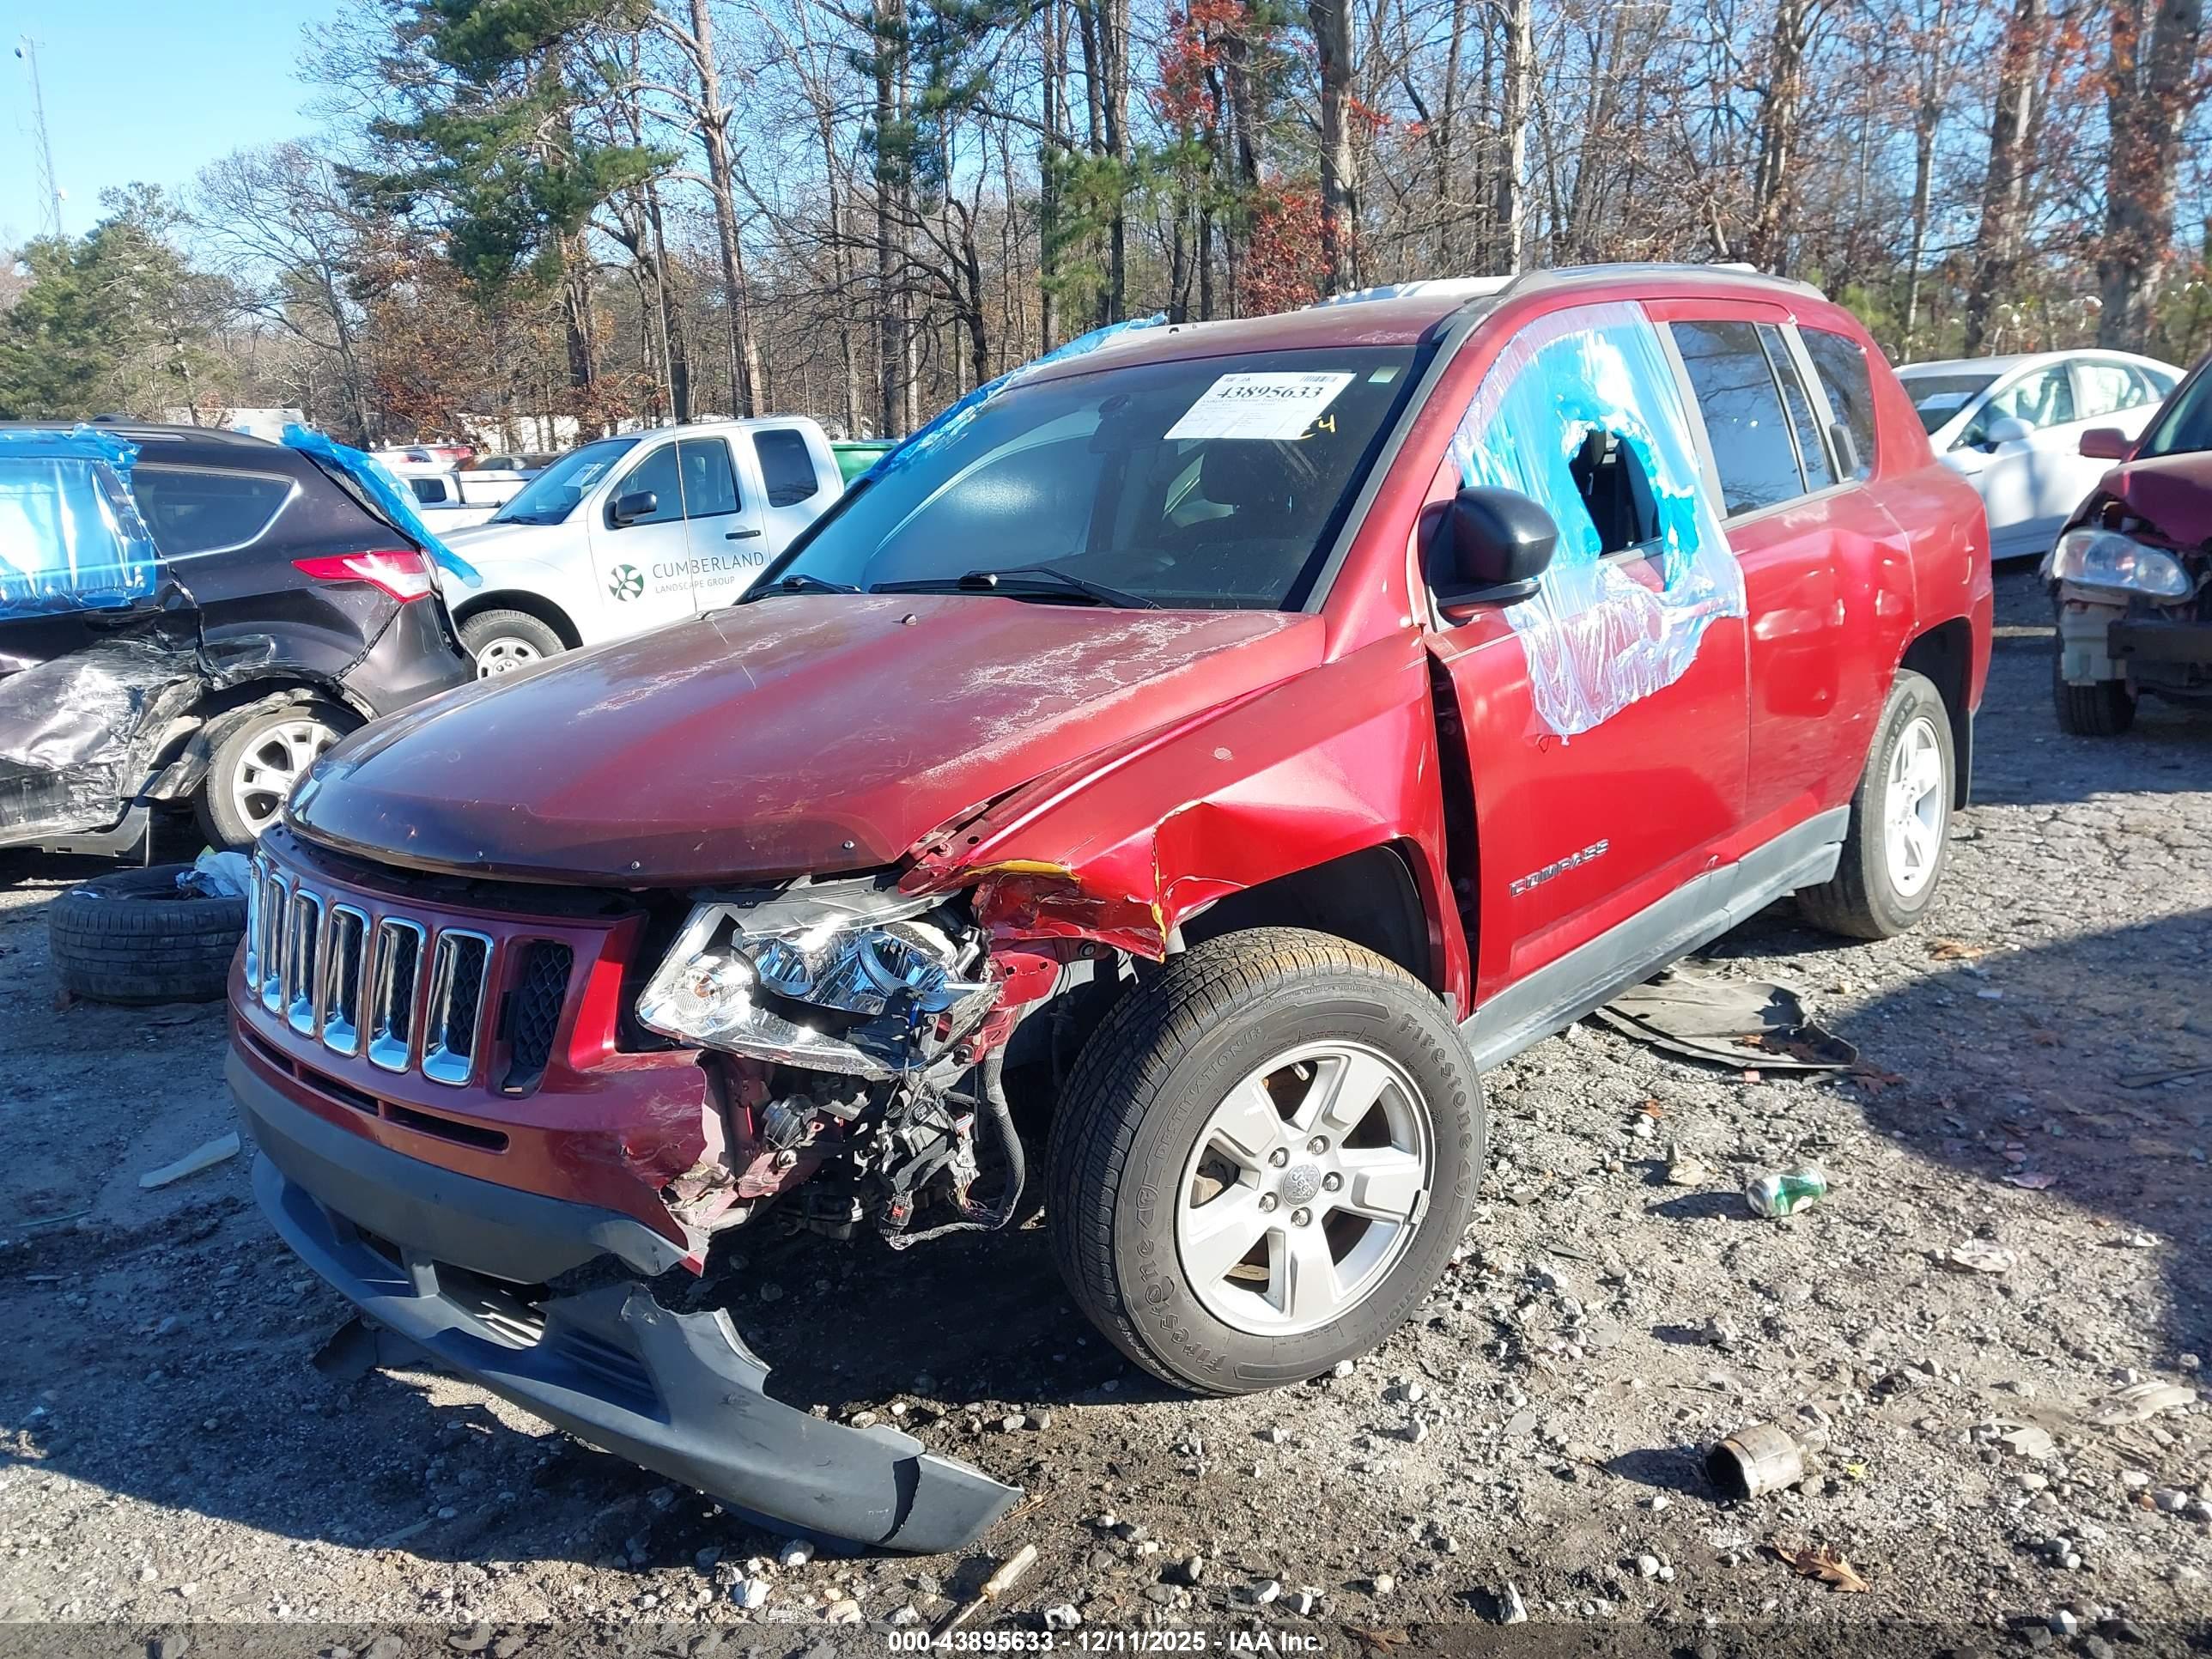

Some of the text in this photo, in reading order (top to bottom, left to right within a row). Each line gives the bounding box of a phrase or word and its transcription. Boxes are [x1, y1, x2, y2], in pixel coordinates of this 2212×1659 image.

[1217, 386, 1324, 398] 43895633
[653, 551, 764, 579] CUMBERLAND
[655, 576, 736, 594] LANDSCAPE GROUP
[1510, 838, 1609, 897] COMPASS
[1154, 1040, 1243, 1159] DESTINATION
[1396, 1012, 1474, 1149] Firestone
[1291, 1173, 1313, 1197] Jeep
[1136, 1238, 1228, 1374] Firestone
